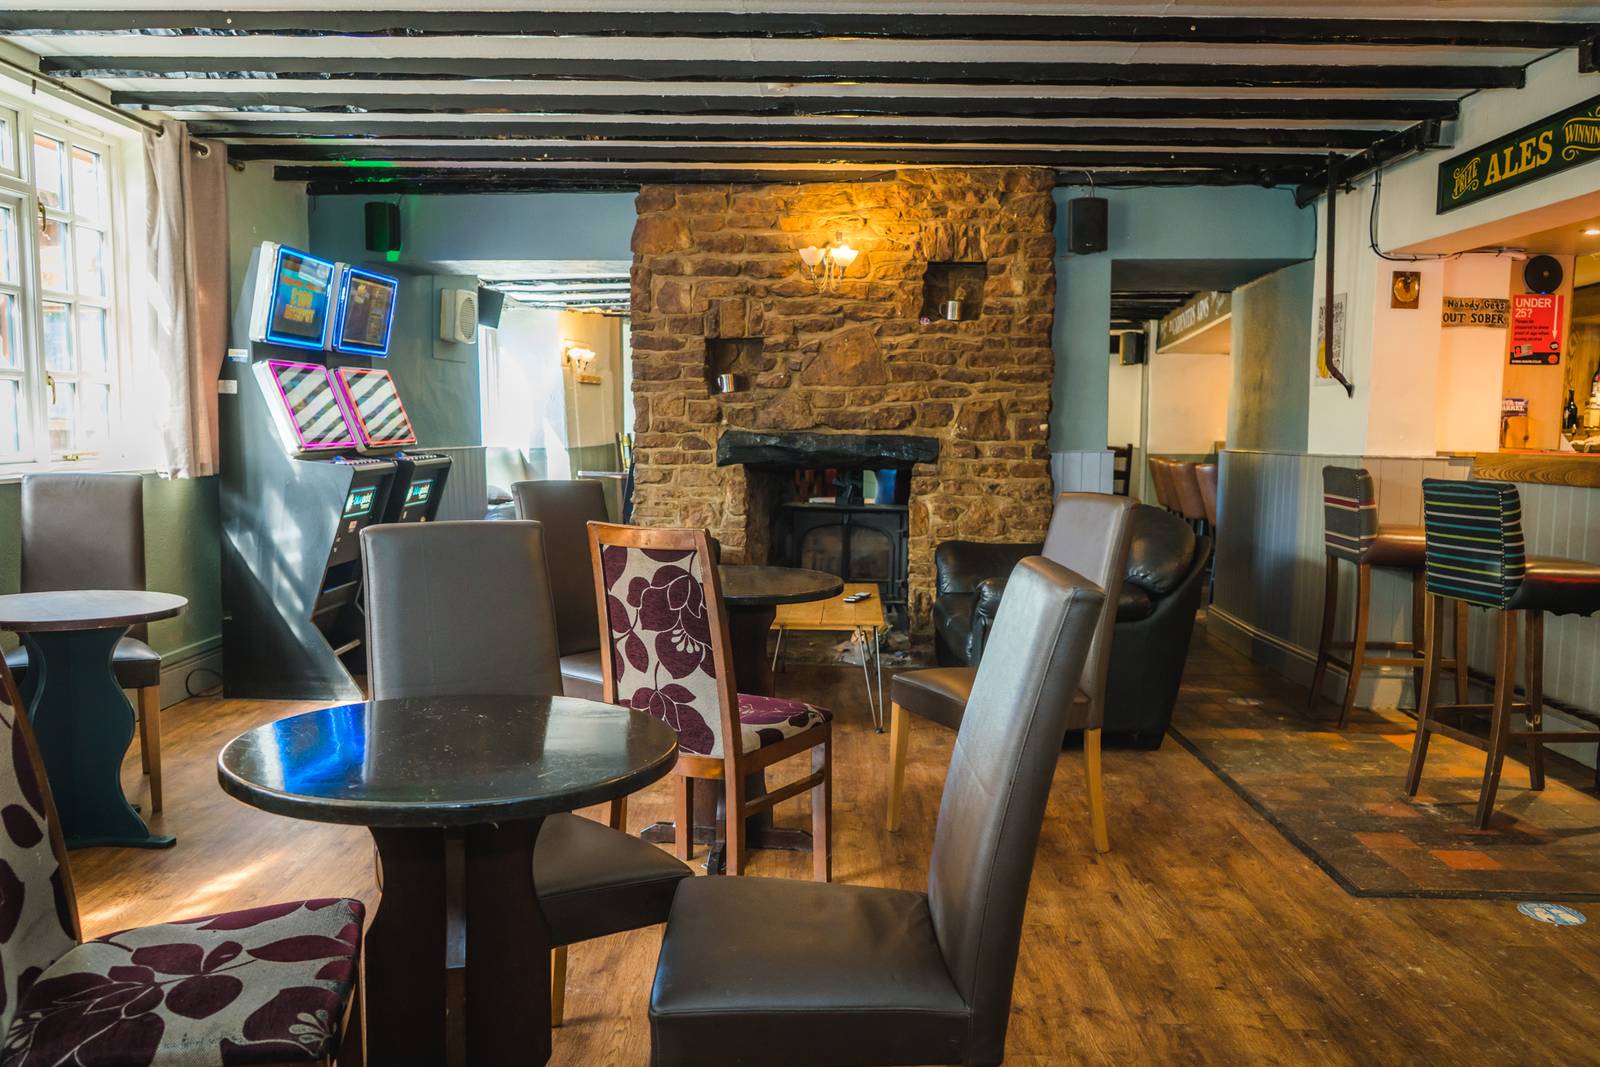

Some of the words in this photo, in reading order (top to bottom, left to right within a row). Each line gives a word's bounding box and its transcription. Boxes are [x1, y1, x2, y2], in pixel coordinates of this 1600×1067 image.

[1454, 160, 1478, 196] PRIZE
[1483, 130, 1553, 187] ALES
[1447, 299, 1480, 310] Nobody
[1483, 299, 1505, 310] Gets
[1515, 297, 1552, 308] UNDER
[1442, 313, 1466, 323] OUT
[1470, 313, 1505, 324] SOBER
[1514, 308, 1533, 318] 25?
